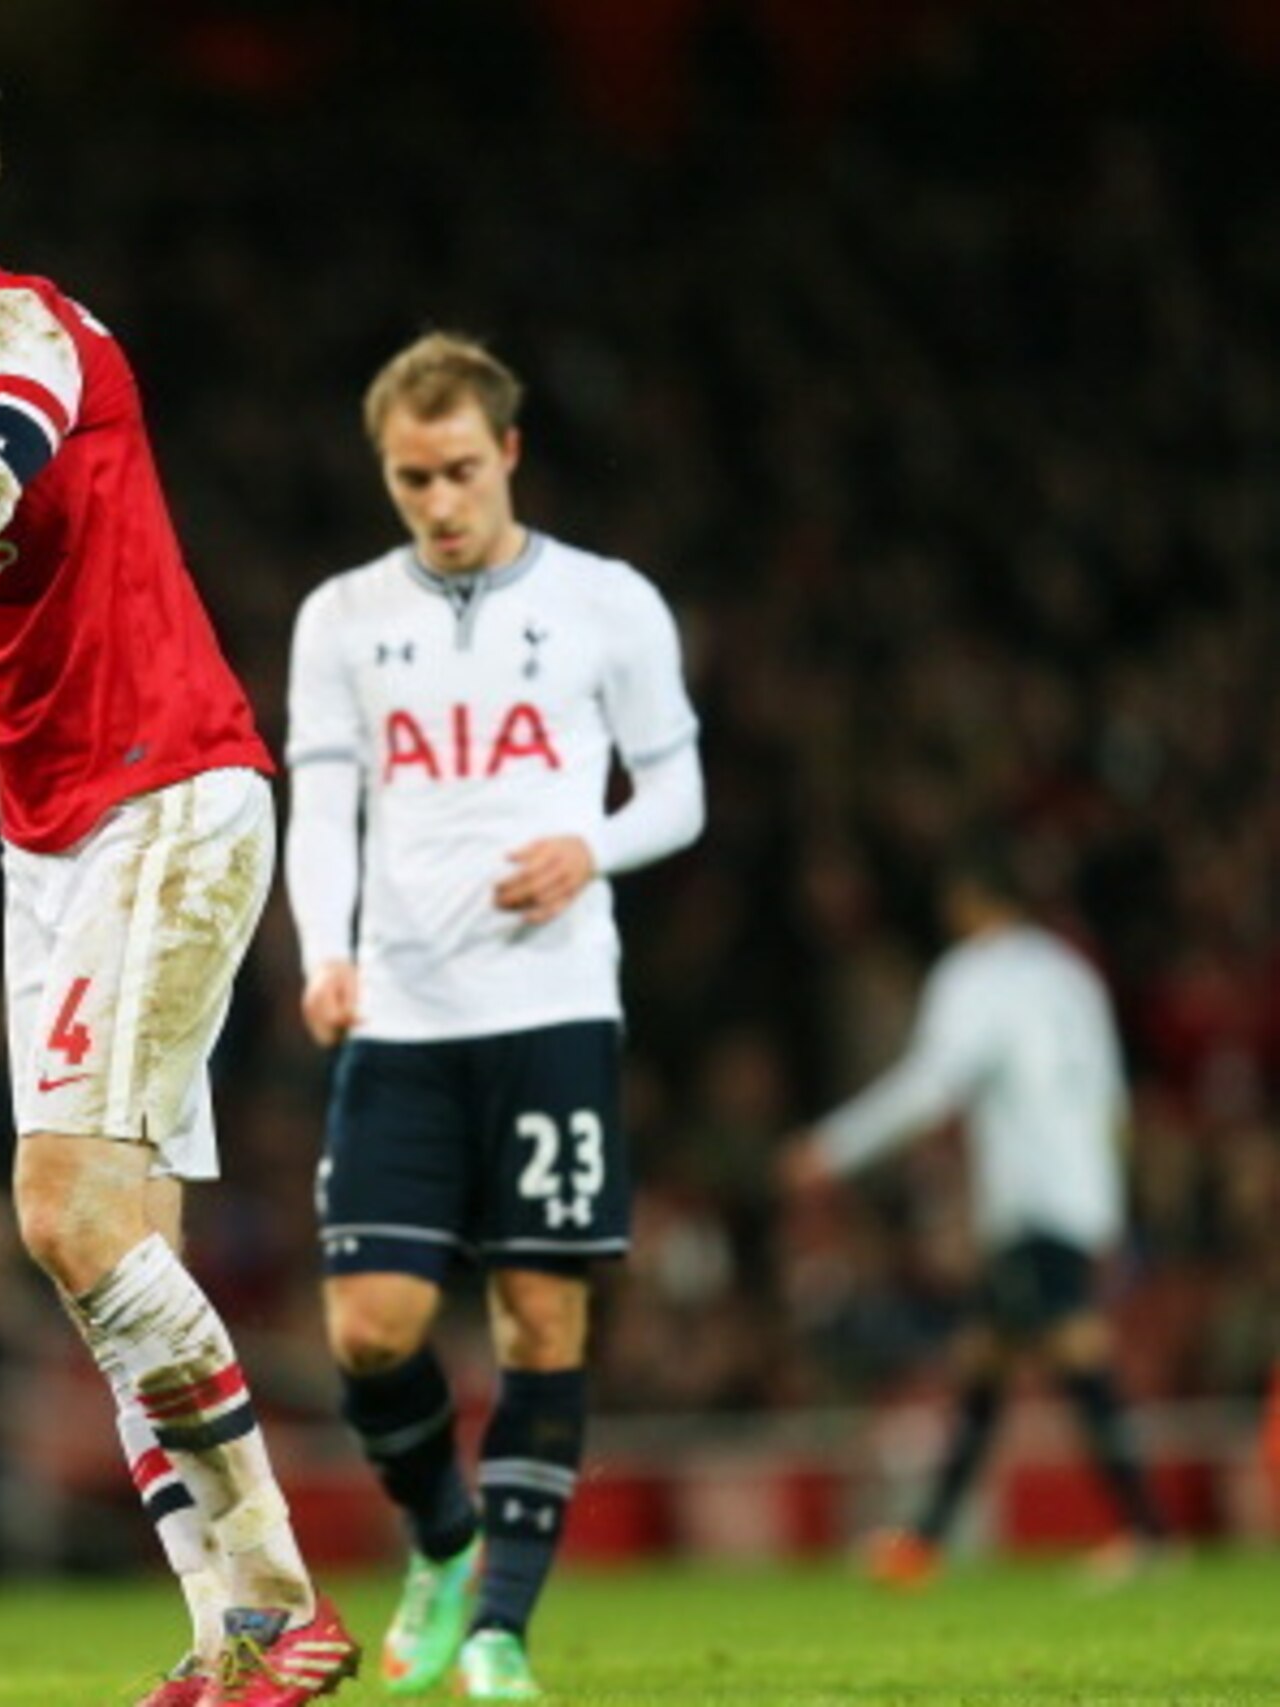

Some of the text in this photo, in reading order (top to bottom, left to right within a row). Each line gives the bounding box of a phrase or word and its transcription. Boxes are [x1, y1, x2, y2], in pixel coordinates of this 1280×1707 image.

[382, 702, 560, 784] AIA
[47, 977, 91, 1065] 4
[516, 1110, 605, 1198] 23
